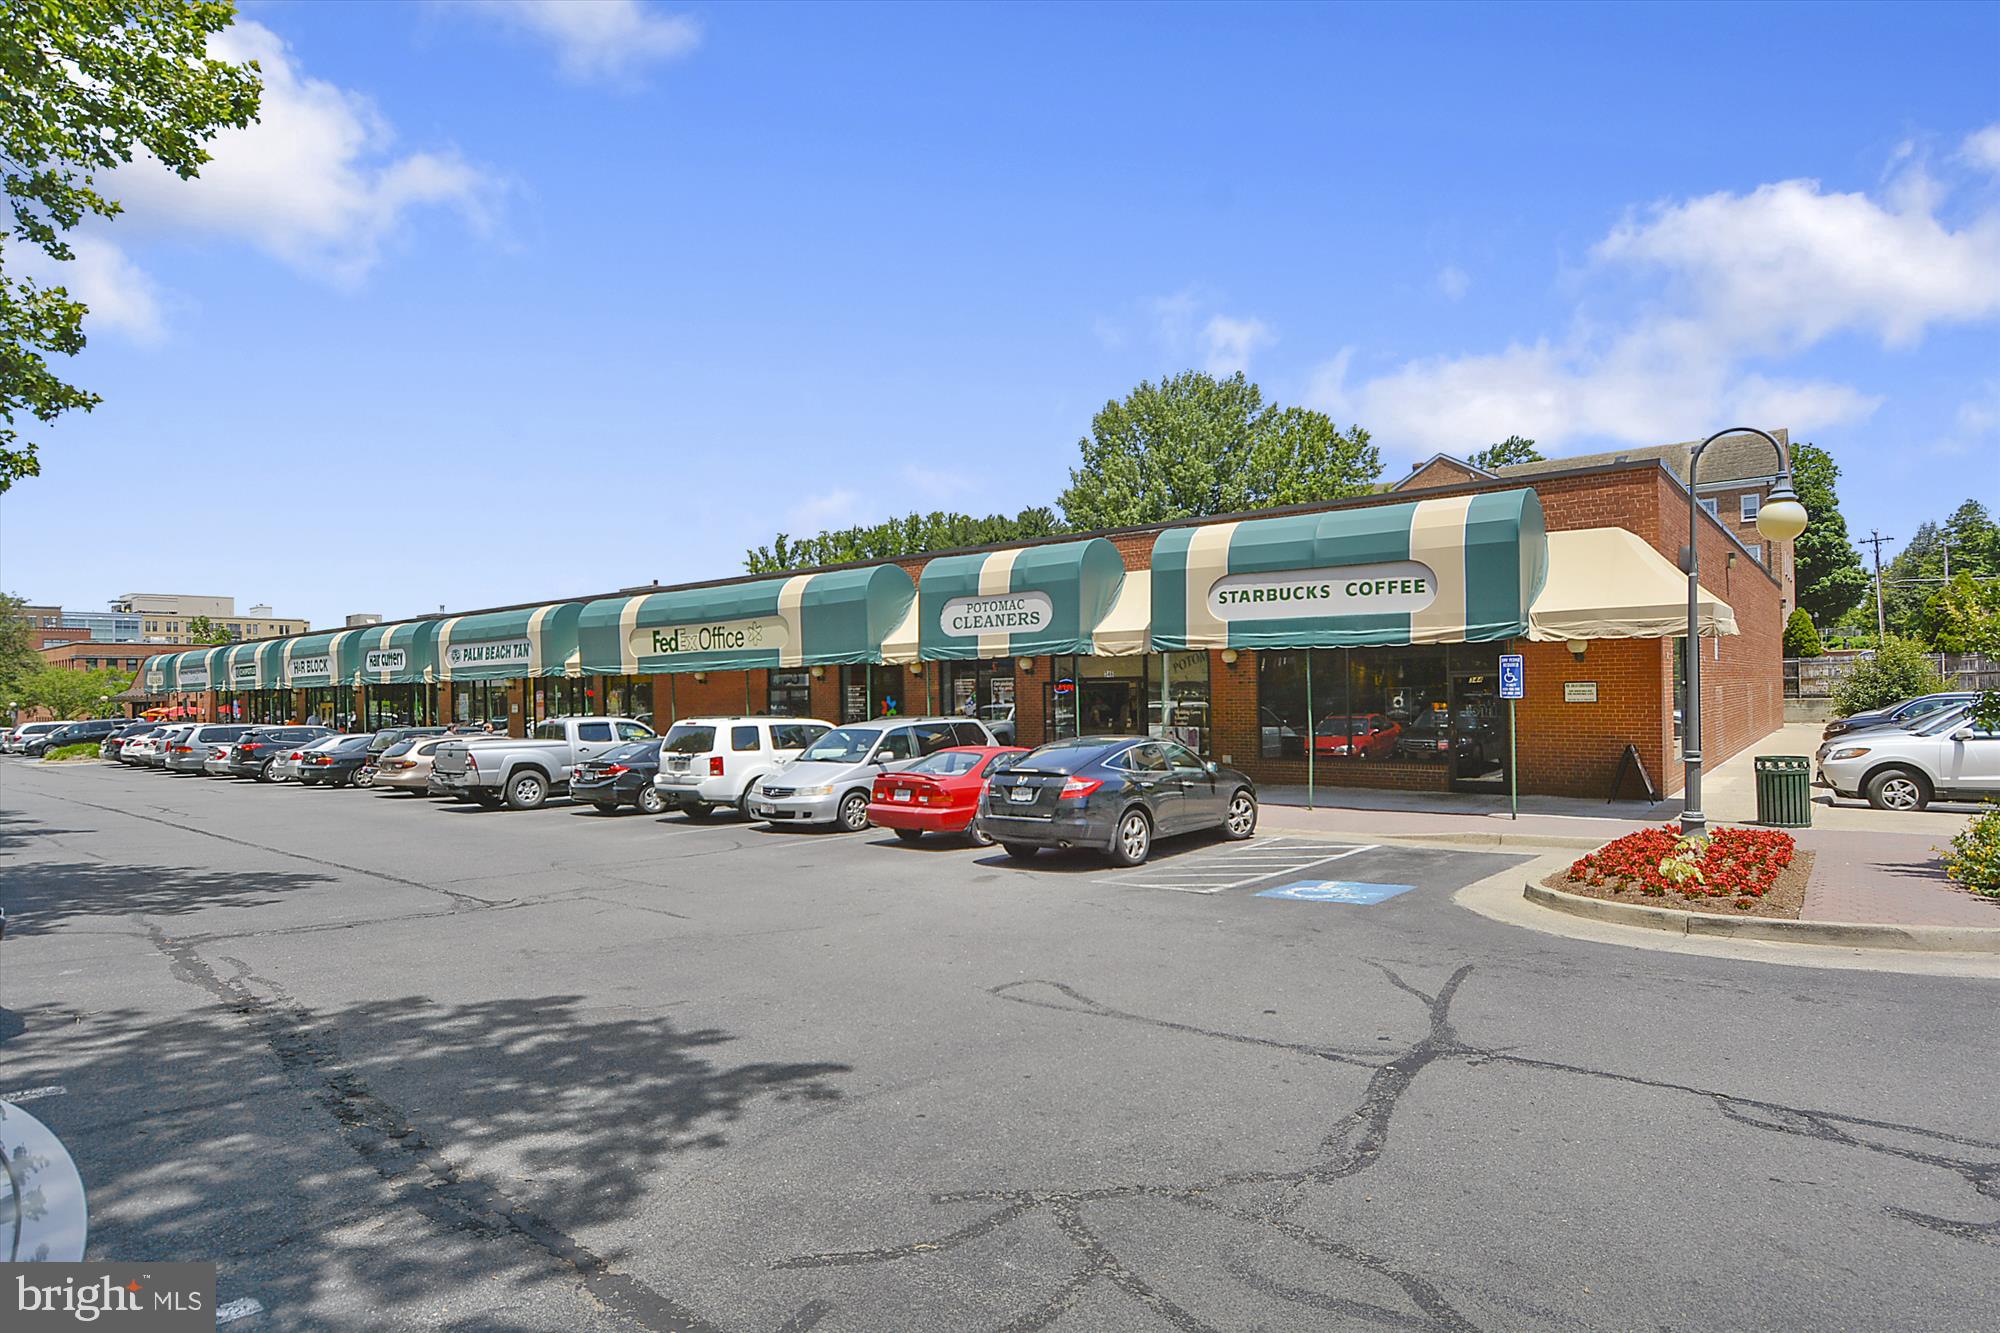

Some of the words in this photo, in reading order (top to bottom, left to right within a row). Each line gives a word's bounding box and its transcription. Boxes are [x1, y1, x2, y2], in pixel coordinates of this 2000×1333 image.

[1219, 584, 1331, 604] STARBUCKS
[1345, 579, 1426, 597] COFFEE
[966, 599, 1025, 614] POTOMAC
[953, 611, 1040, 630] CLEANERS
[652, 628, 698, 653] FedEx
[699, 626, 745, 651] Office
[463, 647, 484, 662] PALM
[485, 644, 511, 661] BEACH
[513, 643, 530, 658] TAN
[306, 658, 329, 673] BLOCK
